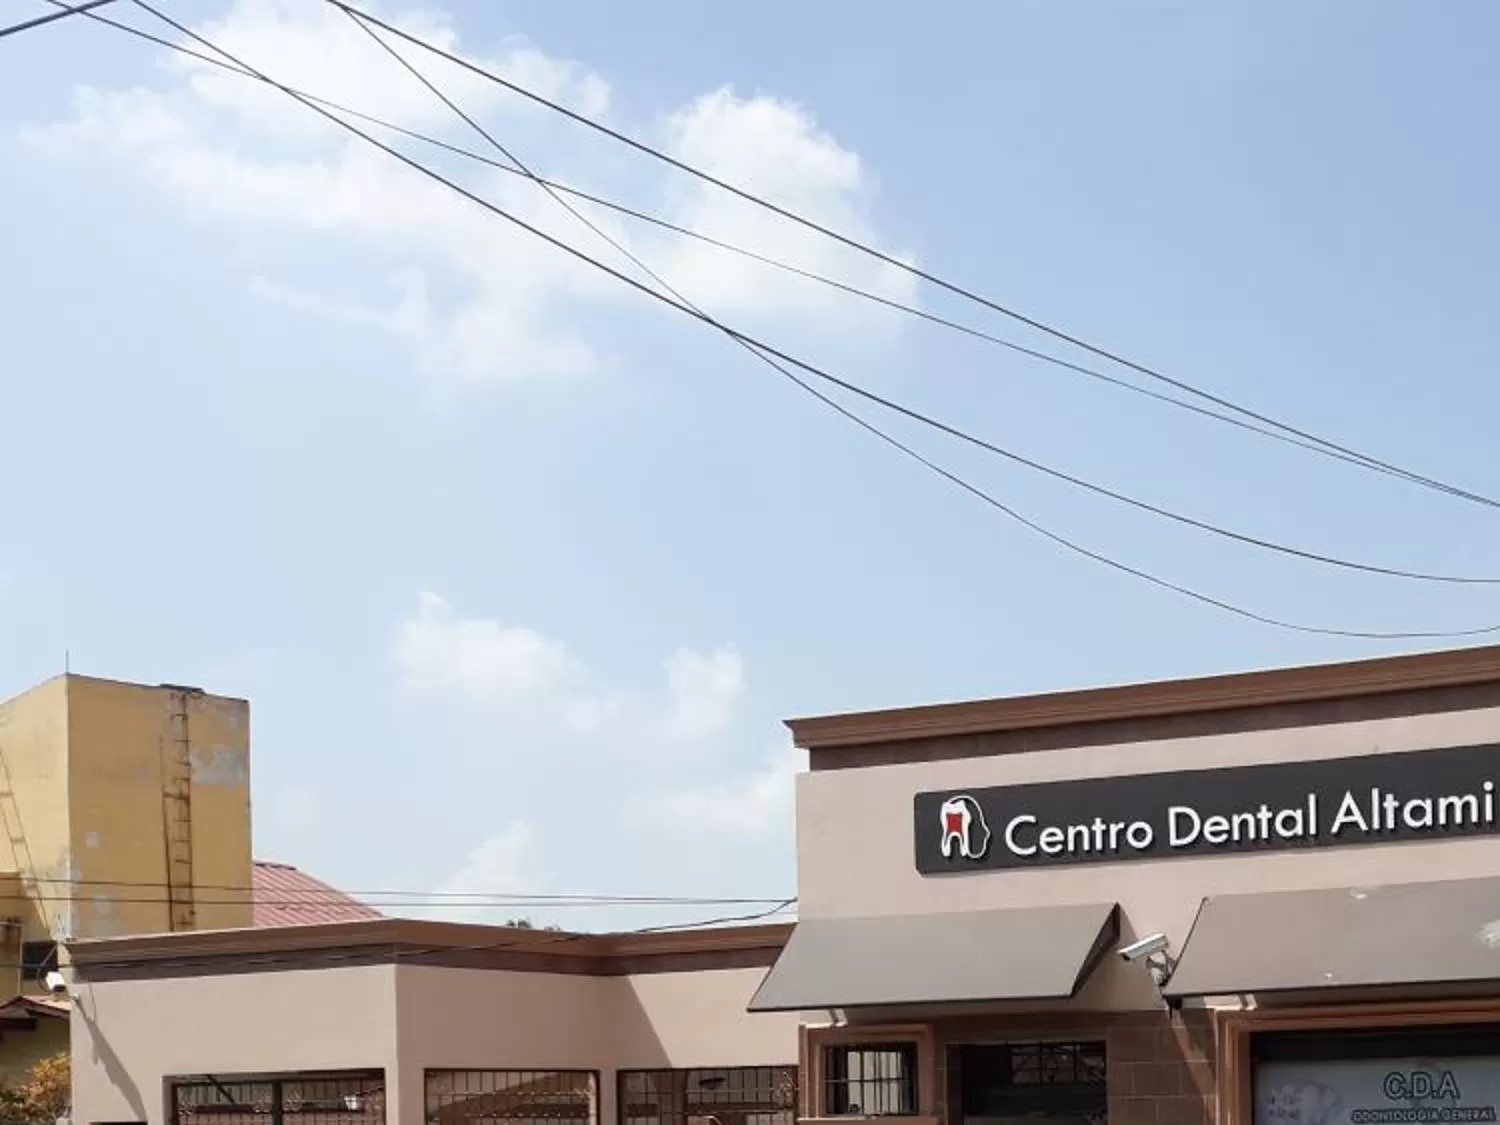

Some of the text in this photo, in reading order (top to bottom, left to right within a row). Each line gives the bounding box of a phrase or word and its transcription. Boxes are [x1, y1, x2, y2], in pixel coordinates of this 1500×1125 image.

[1004, 814, 1154, 856] Centro
[1167, 792, 1317, 847] Dental
[1442, 1106, 1497, 1122] GENERAL
